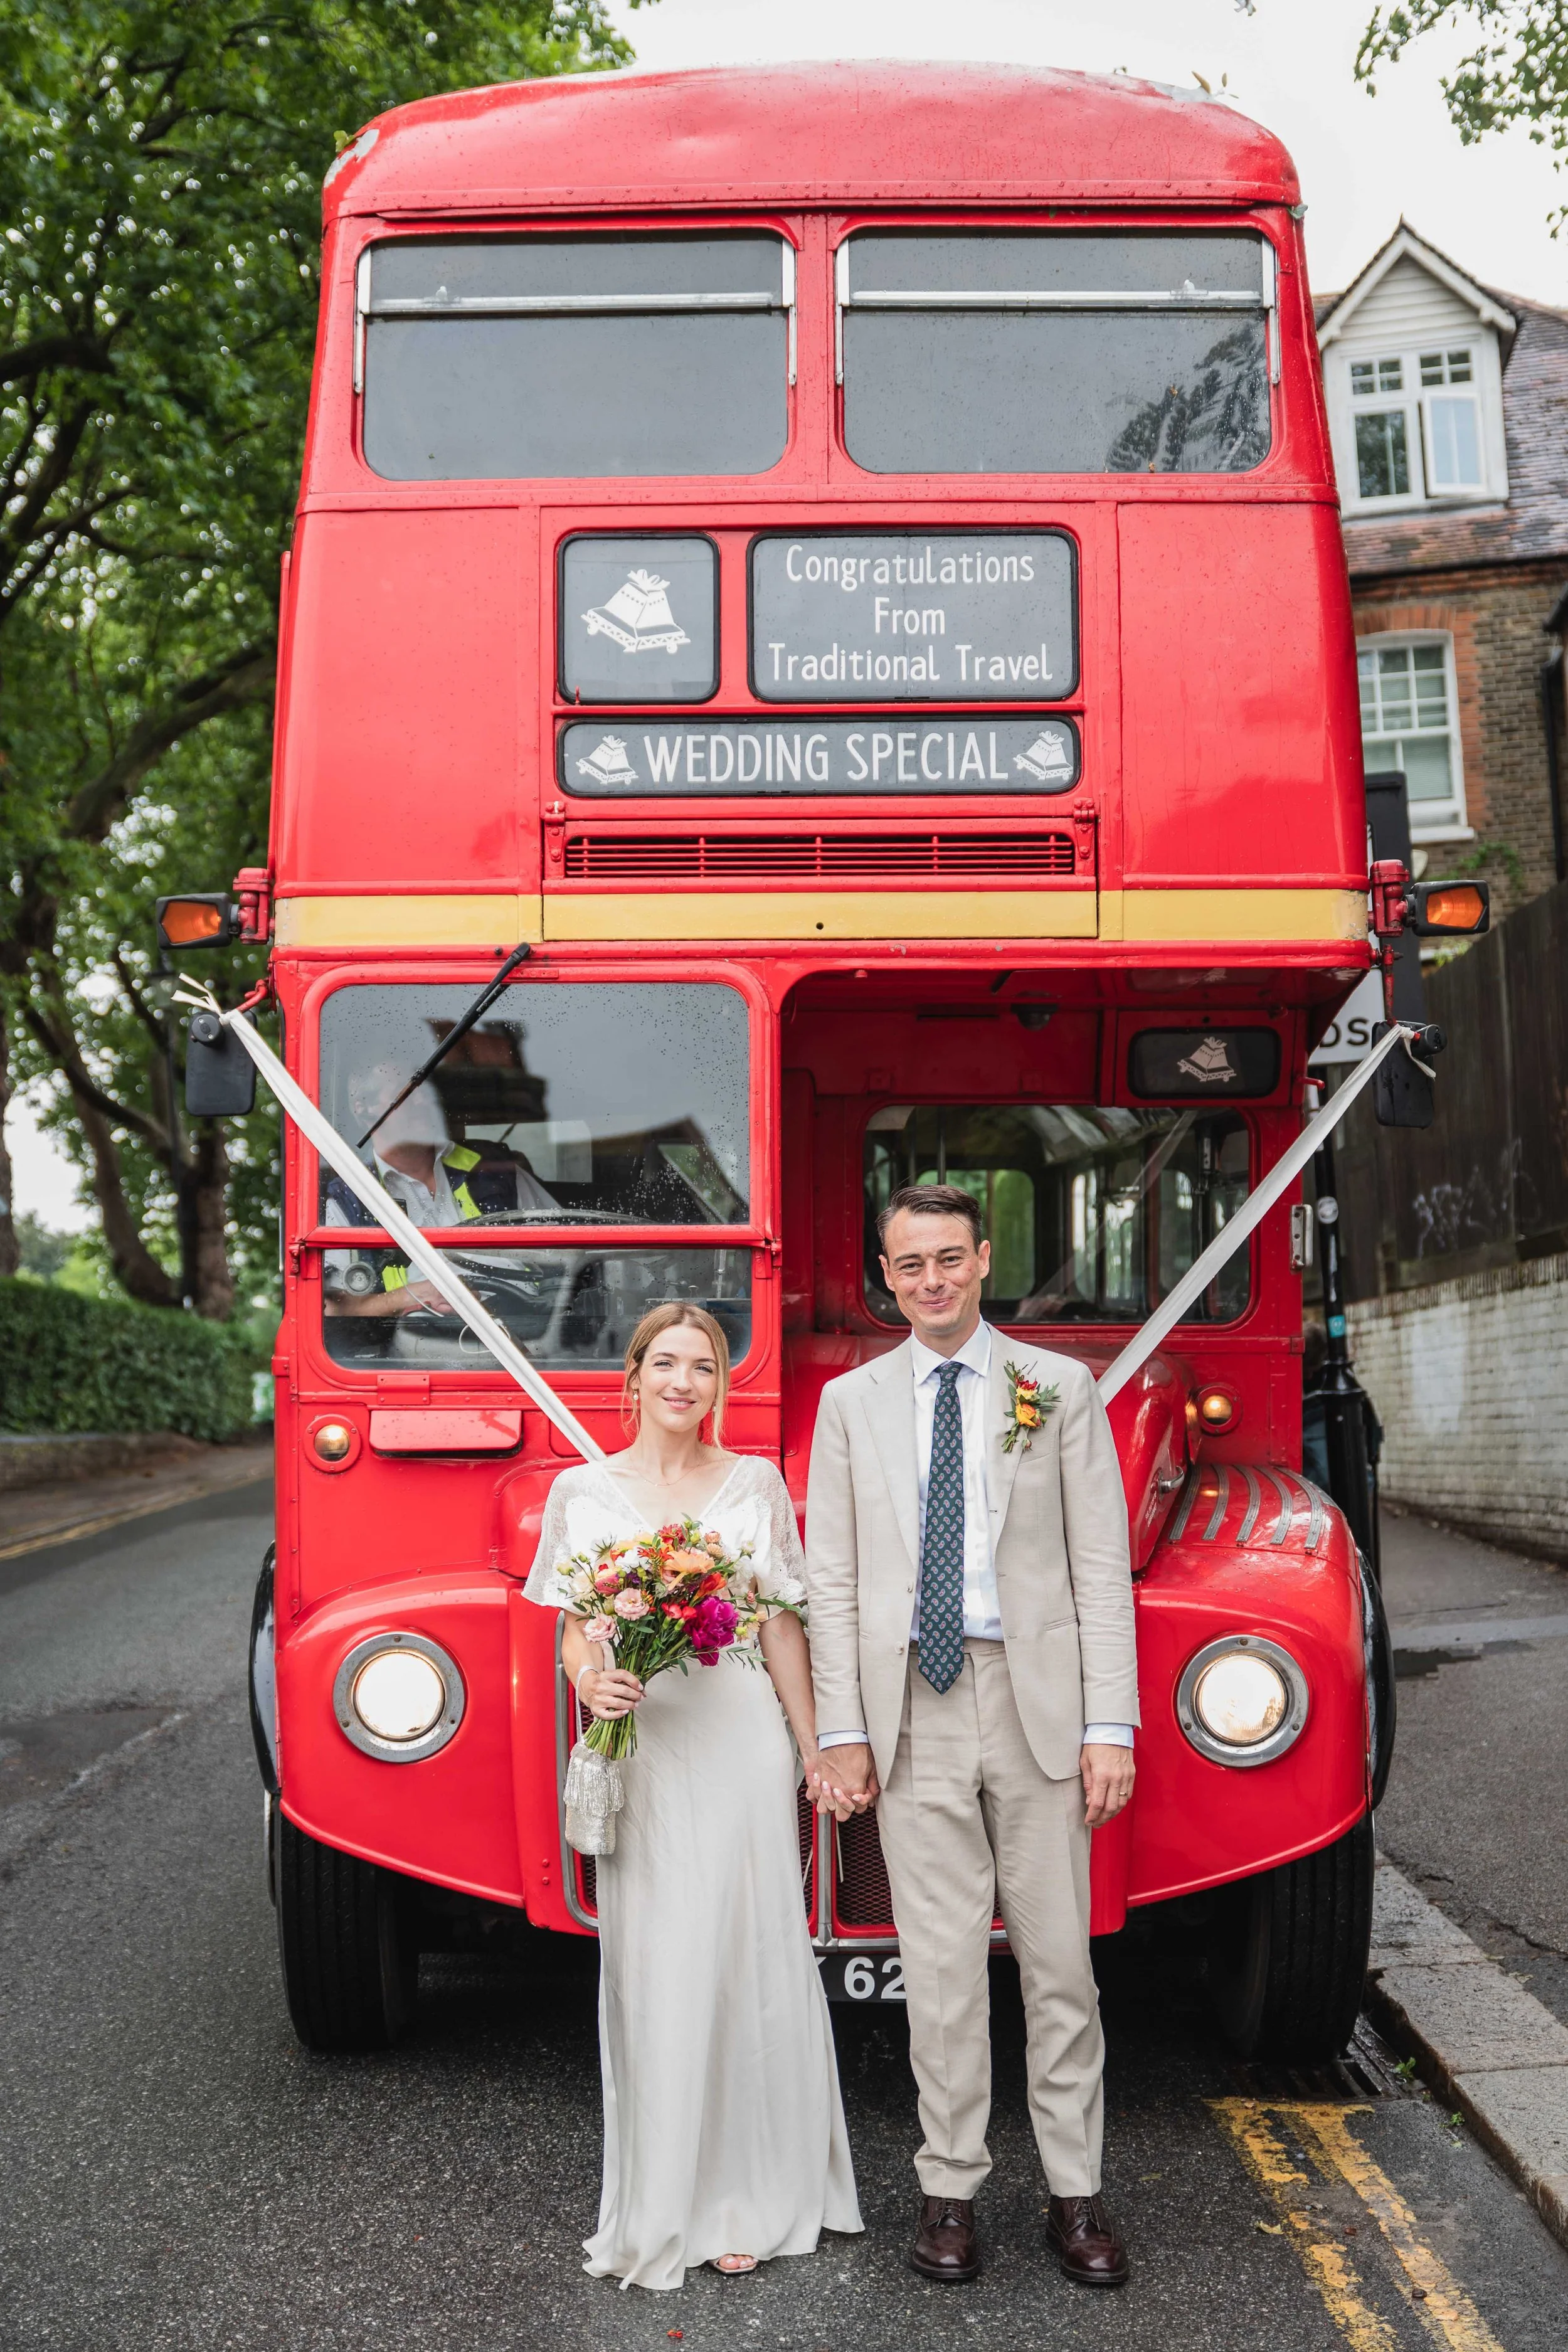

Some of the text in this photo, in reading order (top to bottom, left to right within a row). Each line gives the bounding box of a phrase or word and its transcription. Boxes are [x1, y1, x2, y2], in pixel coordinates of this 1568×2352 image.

[787, 545, 1034, 591] Congratulations
[875, 597, 945, 635] From
[769, 643, 1053, 681] Traditional Travel
[644, 733, 1009, 782] WEDDING SPECIAL
